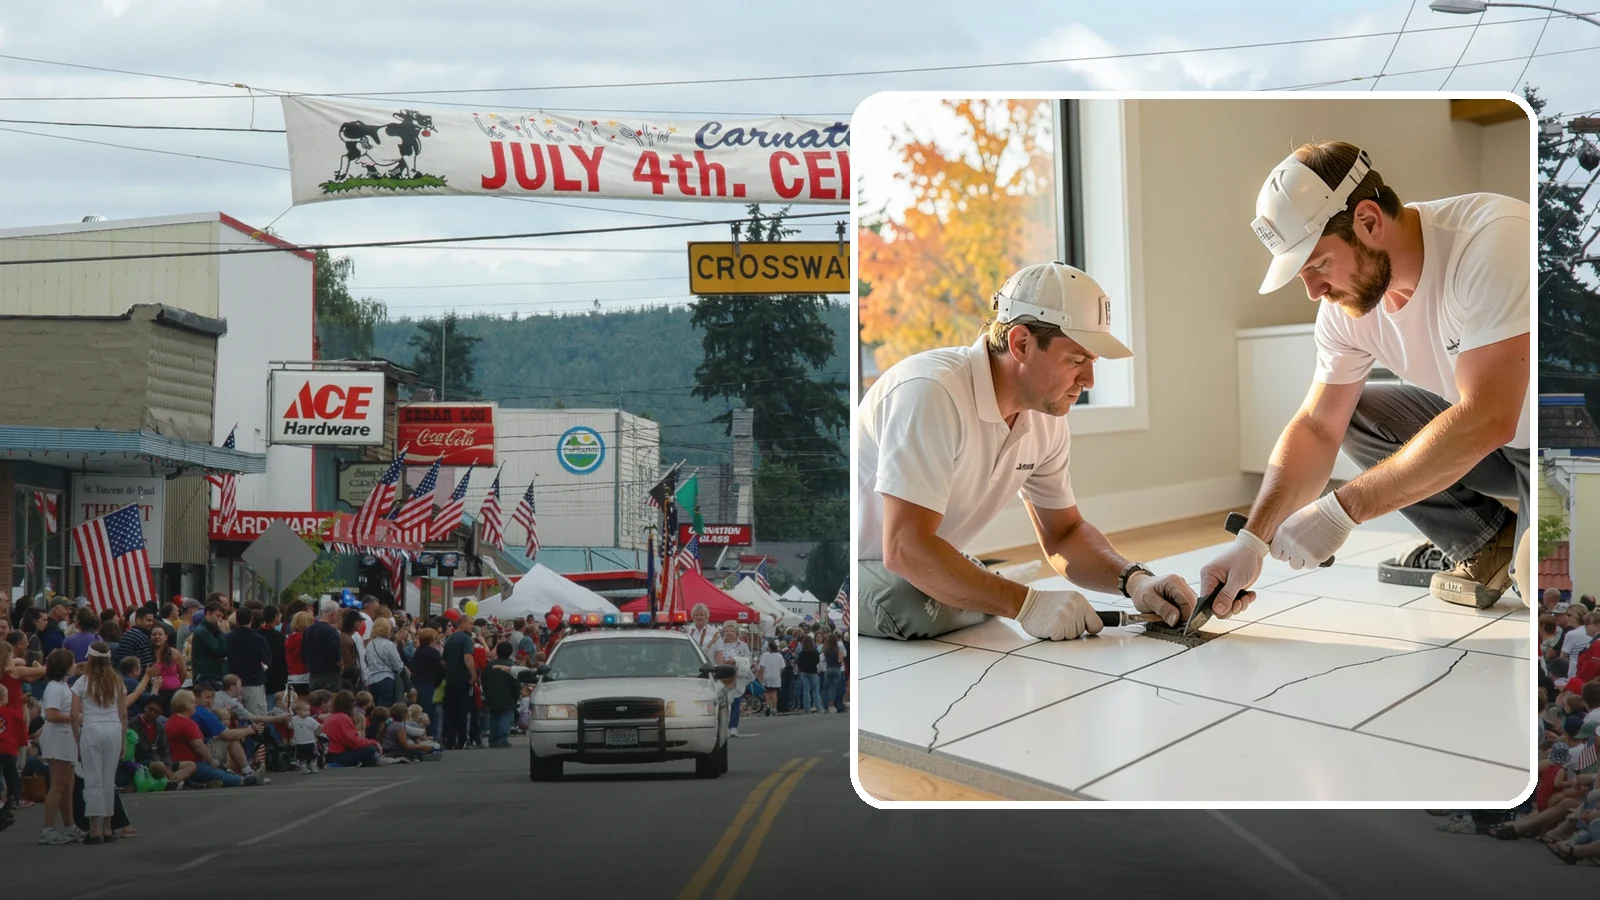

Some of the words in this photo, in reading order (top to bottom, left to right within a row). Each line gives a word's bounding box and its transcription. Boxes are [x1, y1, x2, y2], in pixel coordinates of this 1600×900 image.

[481, 140, 605, 193] JULY
[632, 150, 747, 198] 4th.
[697, 253, 850, 280] CROSSWA
[283, 380, 374, 420] ACE
[283, 420, 371, 437] Hardware
[416, 428, 477, 447] Coca-Cola
[95, 485, 124, 495] Vincent
[126, 485, 136, 495] de
[137, 486, 155, 495] Paul
[688, 526, 741, 535] CRNATION
[699, 535, 730, 543] GLASS
